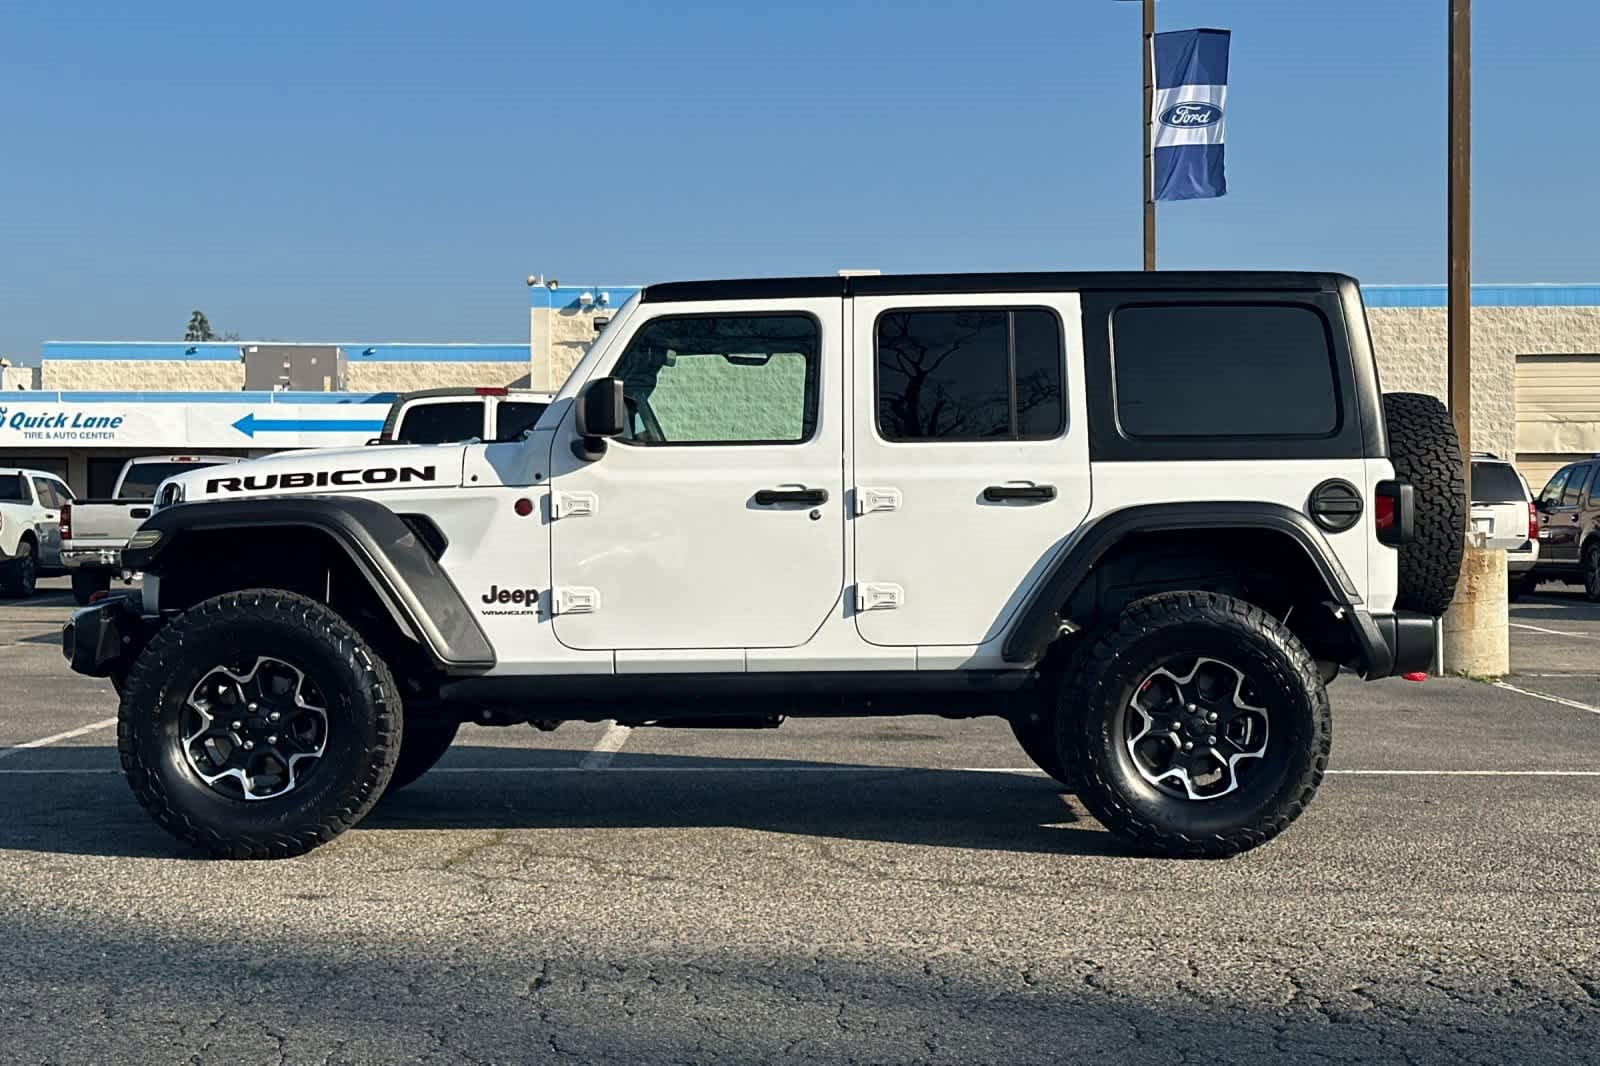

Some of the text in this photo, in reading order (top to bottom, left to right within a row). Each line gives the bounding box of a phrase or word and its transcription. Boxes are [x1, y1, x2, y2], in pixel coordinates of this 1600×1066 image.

[1172, 106, 1211, 123] Ford
[9, 412, 123, 430] Quick Lane
[24, 431, 115, 439] TIRE & AUTO CENTER
[205, 465, 436, 494] RUBICON
[481, 585, 539, 607] Jeep
